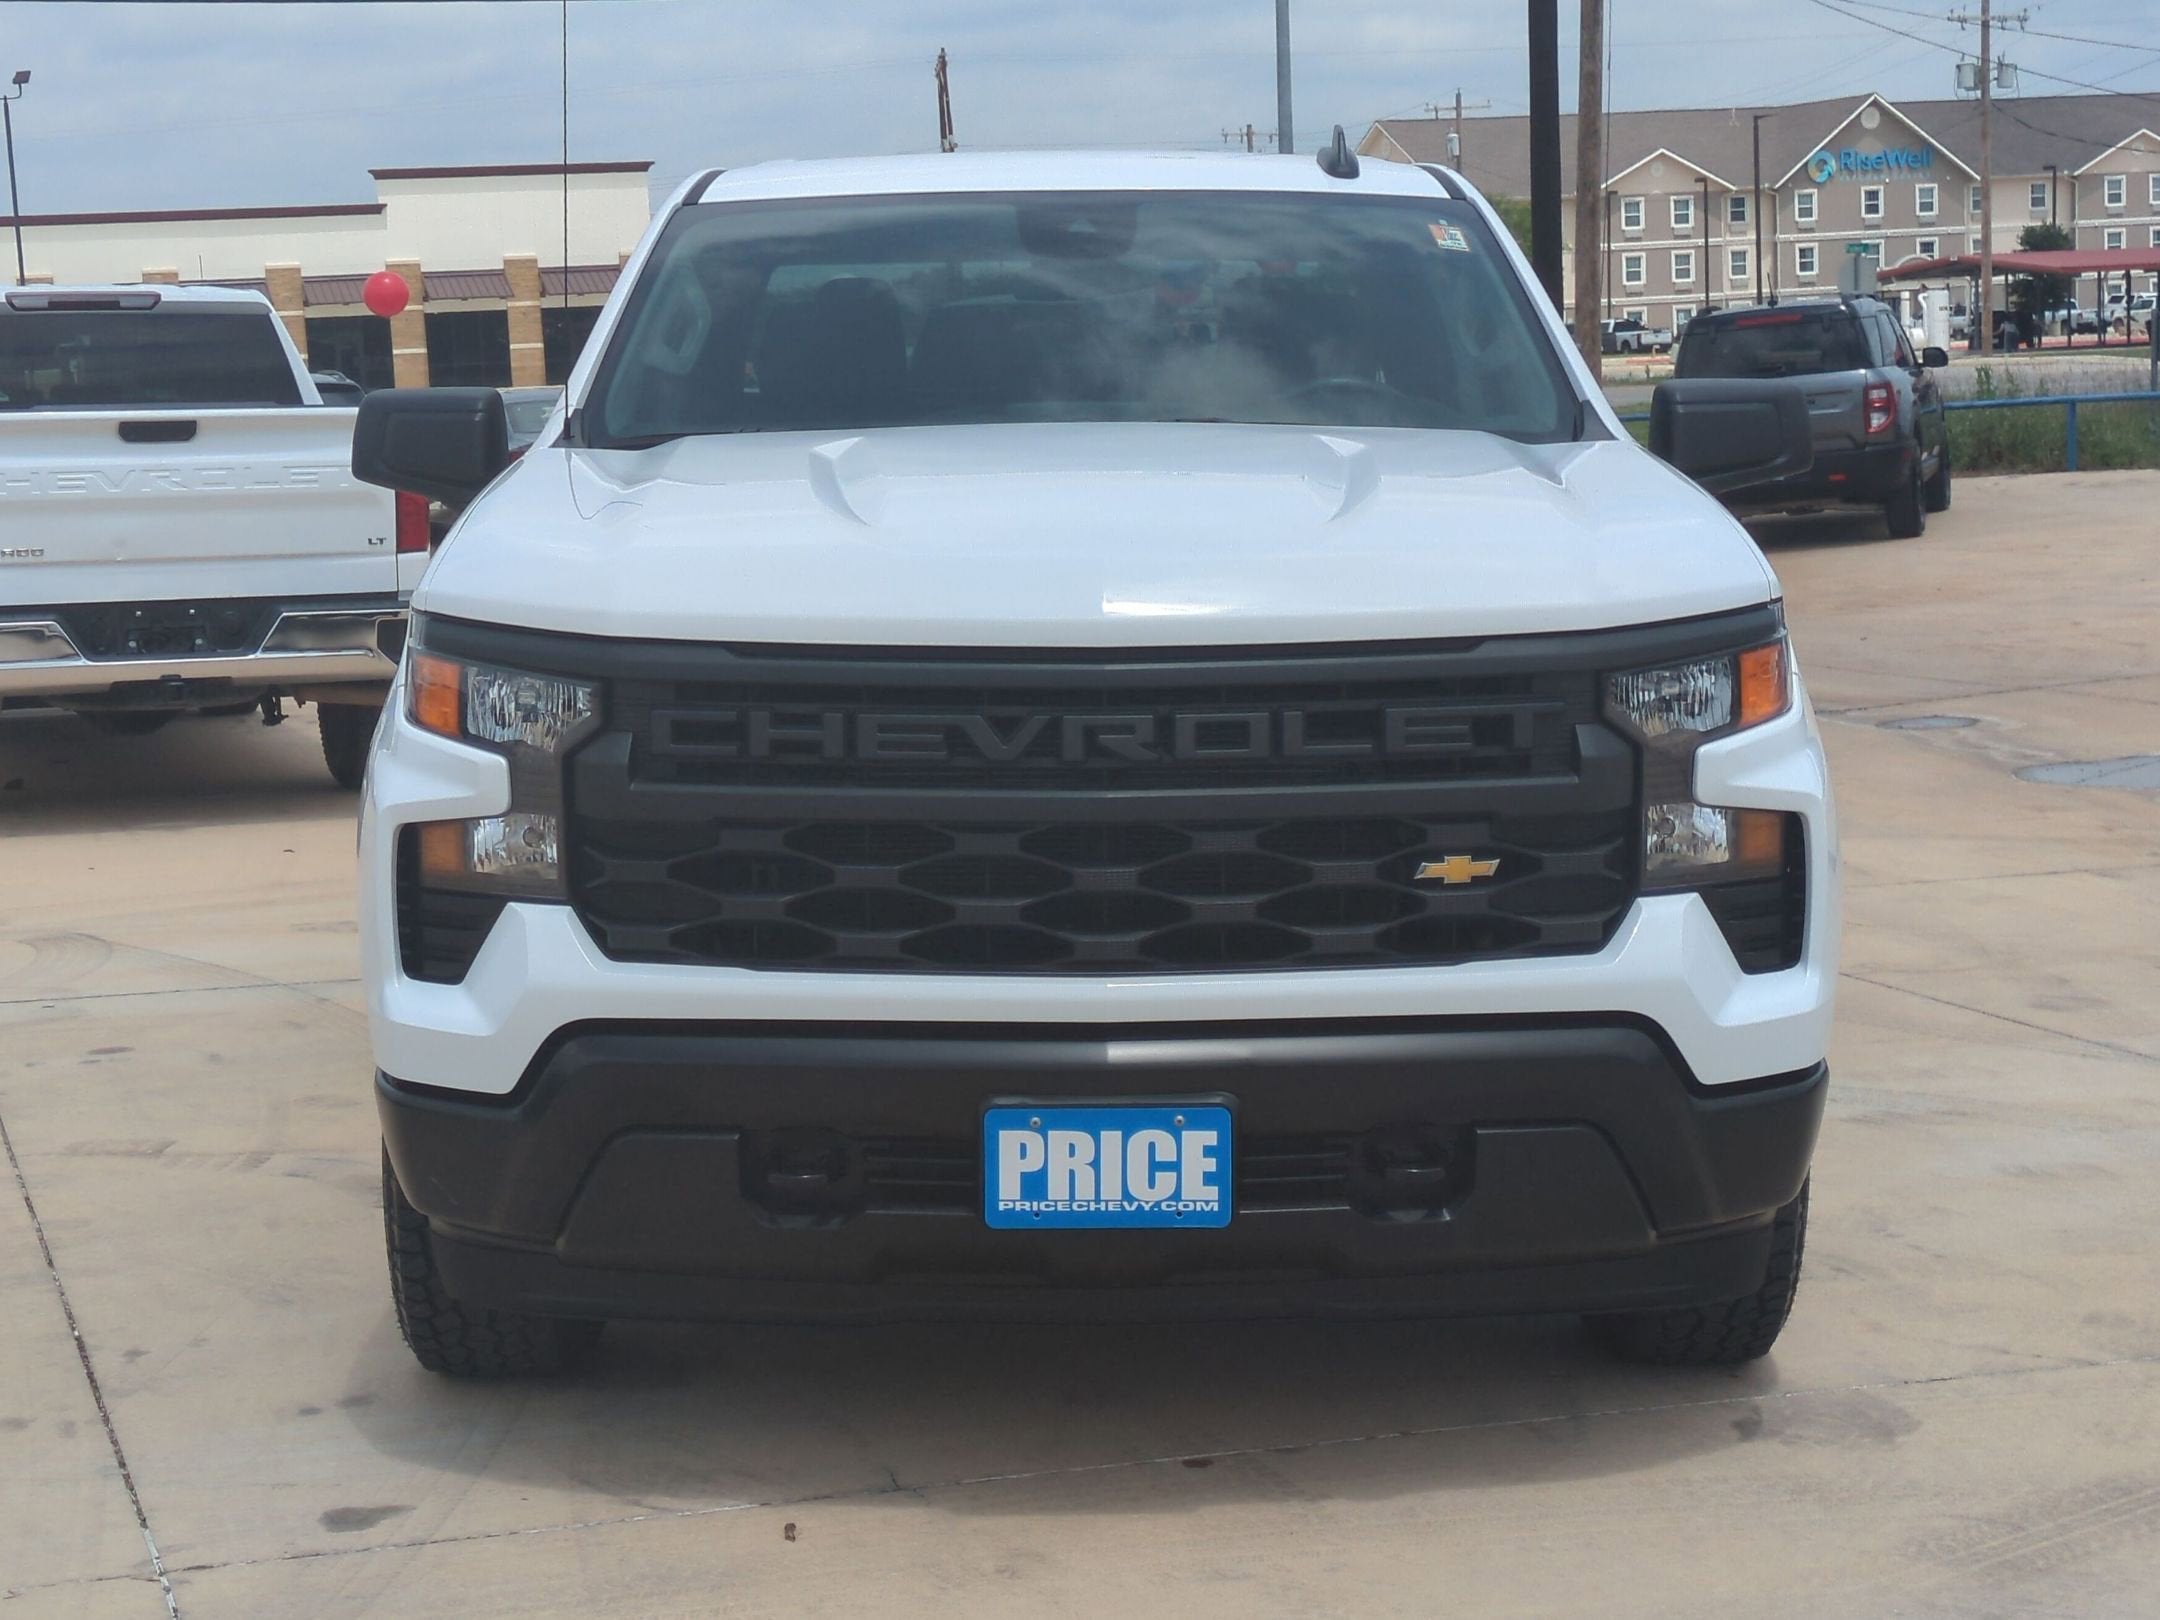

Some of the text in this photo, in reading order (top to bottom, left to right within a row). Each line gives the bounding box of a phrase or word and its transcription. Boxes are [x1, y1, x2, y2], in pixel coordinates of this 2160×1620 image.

[1840, 147, 1931, 171] RiseWell
[368, 537, 387, 545] LT
[651, 704, 1564, 761] CHEVROLET
[999, 1129, 1219, 1201] PRICE
[999, 1201, 1219, 1212] PRICECHEVY.COM
